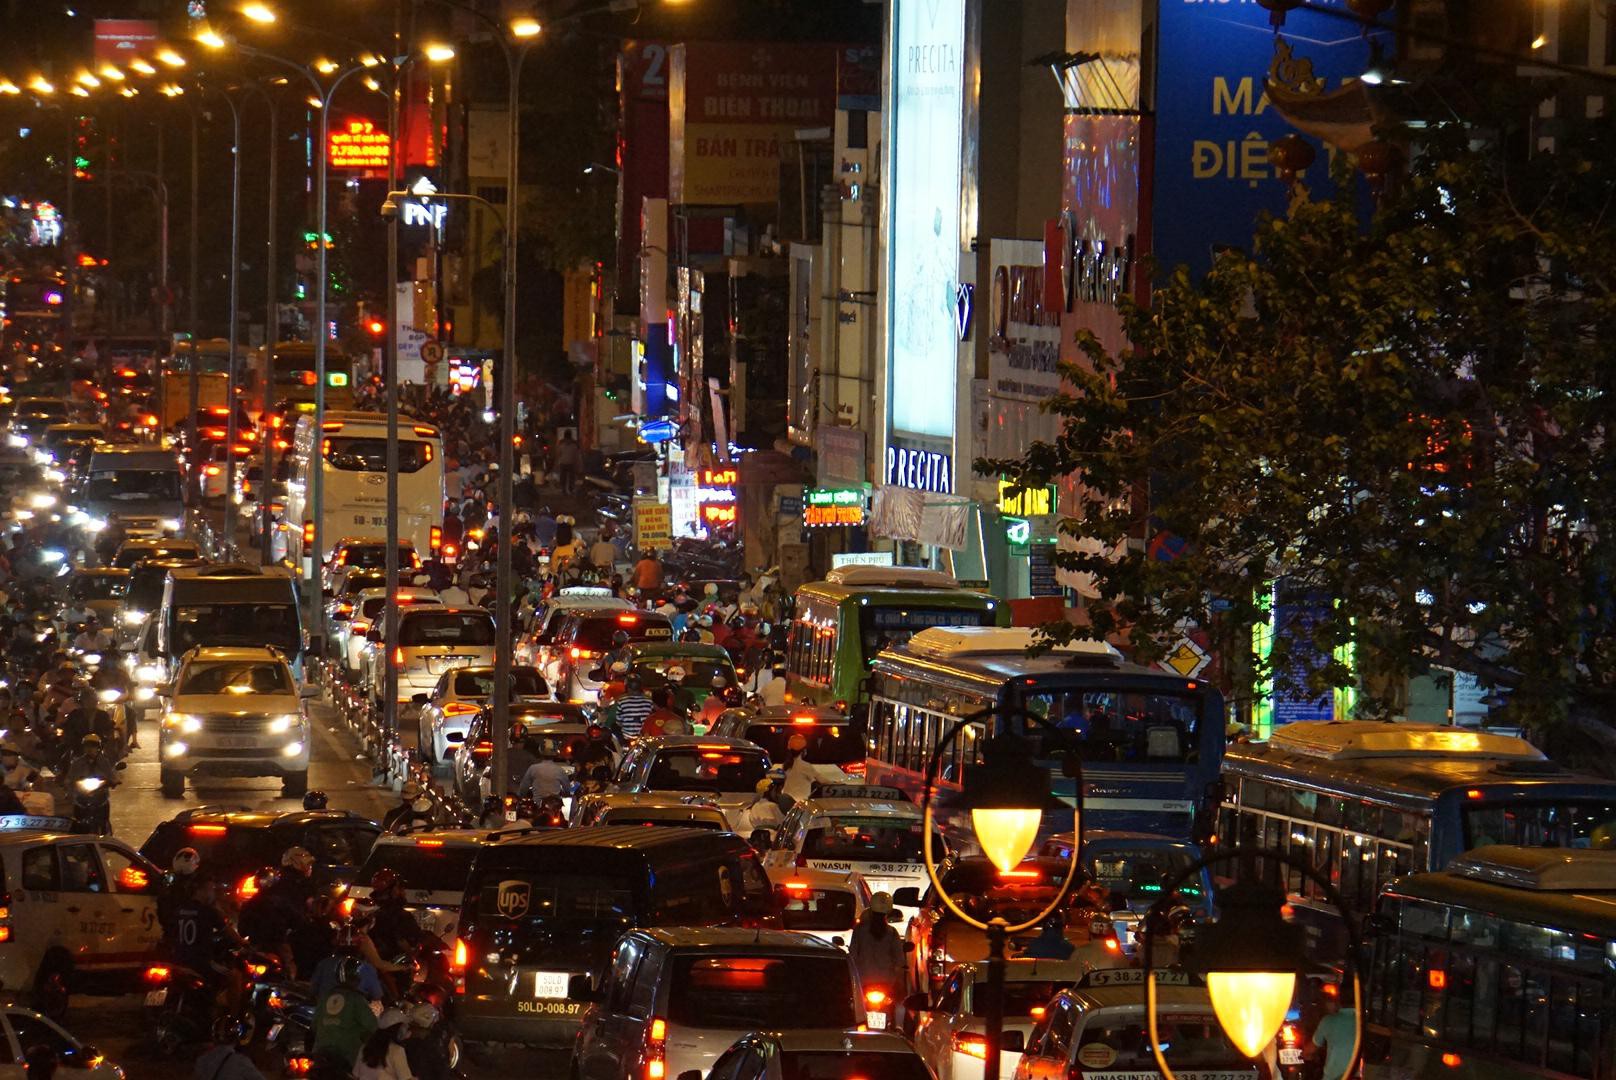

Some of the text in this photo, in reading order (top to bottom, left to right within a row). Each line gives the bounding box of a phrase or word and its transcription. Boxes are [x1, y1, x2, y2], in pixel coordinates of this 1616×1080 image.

[908, 43, 955, 74] PRECITA
[888, 447, 949, 494] PRECITA
[813, 861, 852, 871] VINASUN
[500, 892, 527, 913] ups
[178, 919, 197, 946] 10
[1114, 971, 1148, 982] 38.2
[517, 1001, 581, 1014] 50LD-008.97
